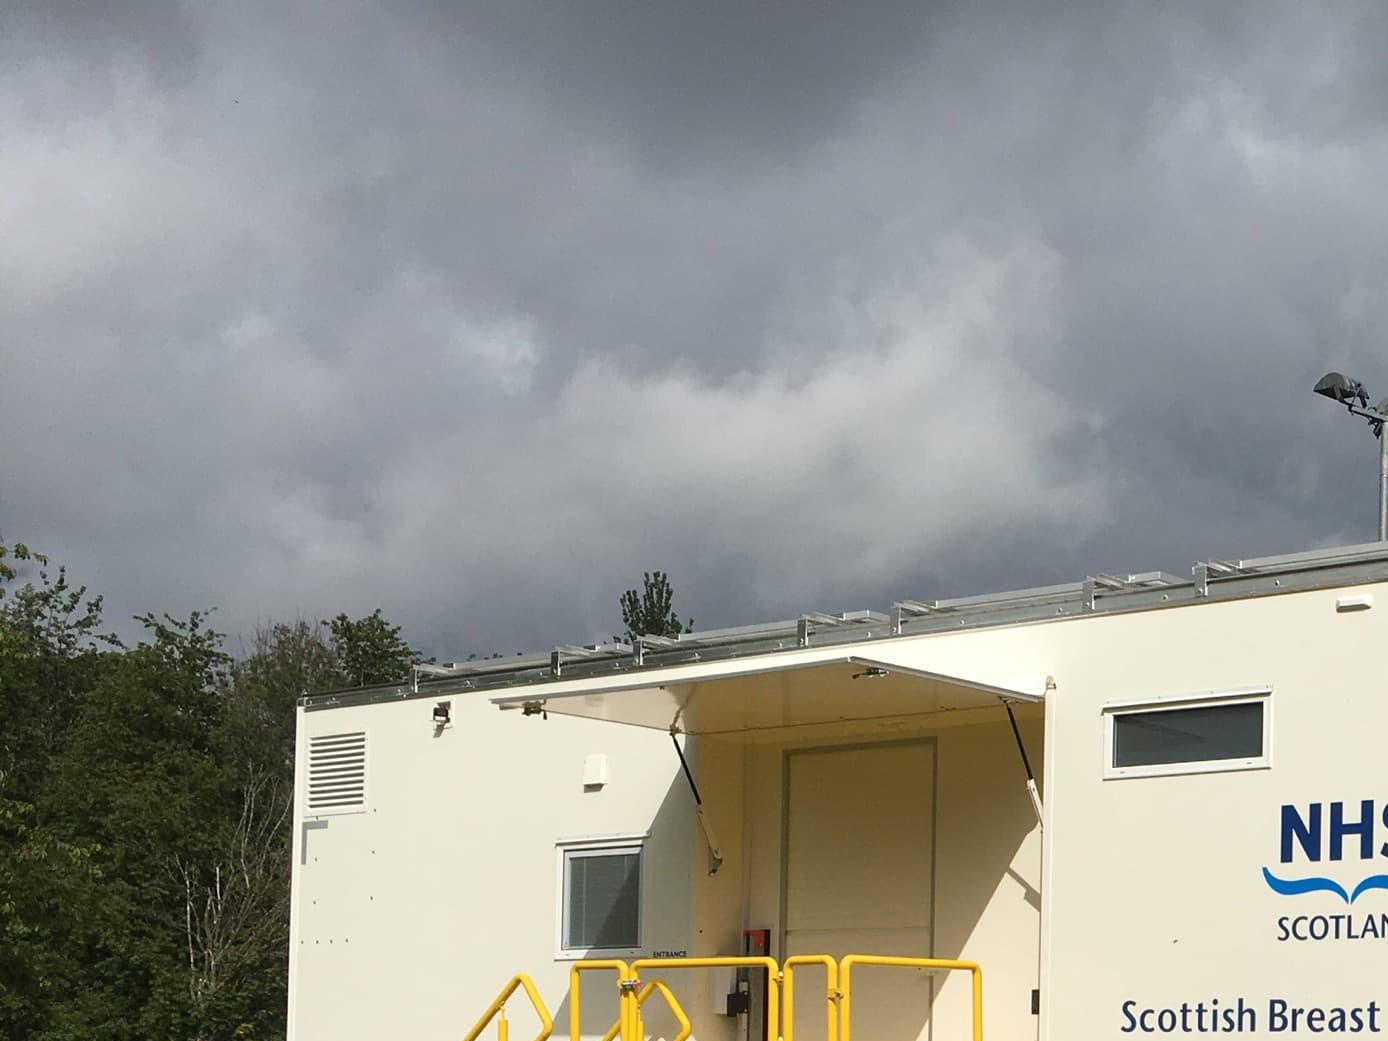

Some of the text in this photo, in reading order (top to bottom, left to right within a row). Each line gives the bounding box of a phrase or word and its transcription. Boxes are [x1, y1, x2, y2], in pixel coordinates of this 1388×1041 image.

[652, 950, 688, 959] ENTRANCE
[1120, 998, 1257, 1034] Scottish
[1269, 998, 1382, 1034] Breast
